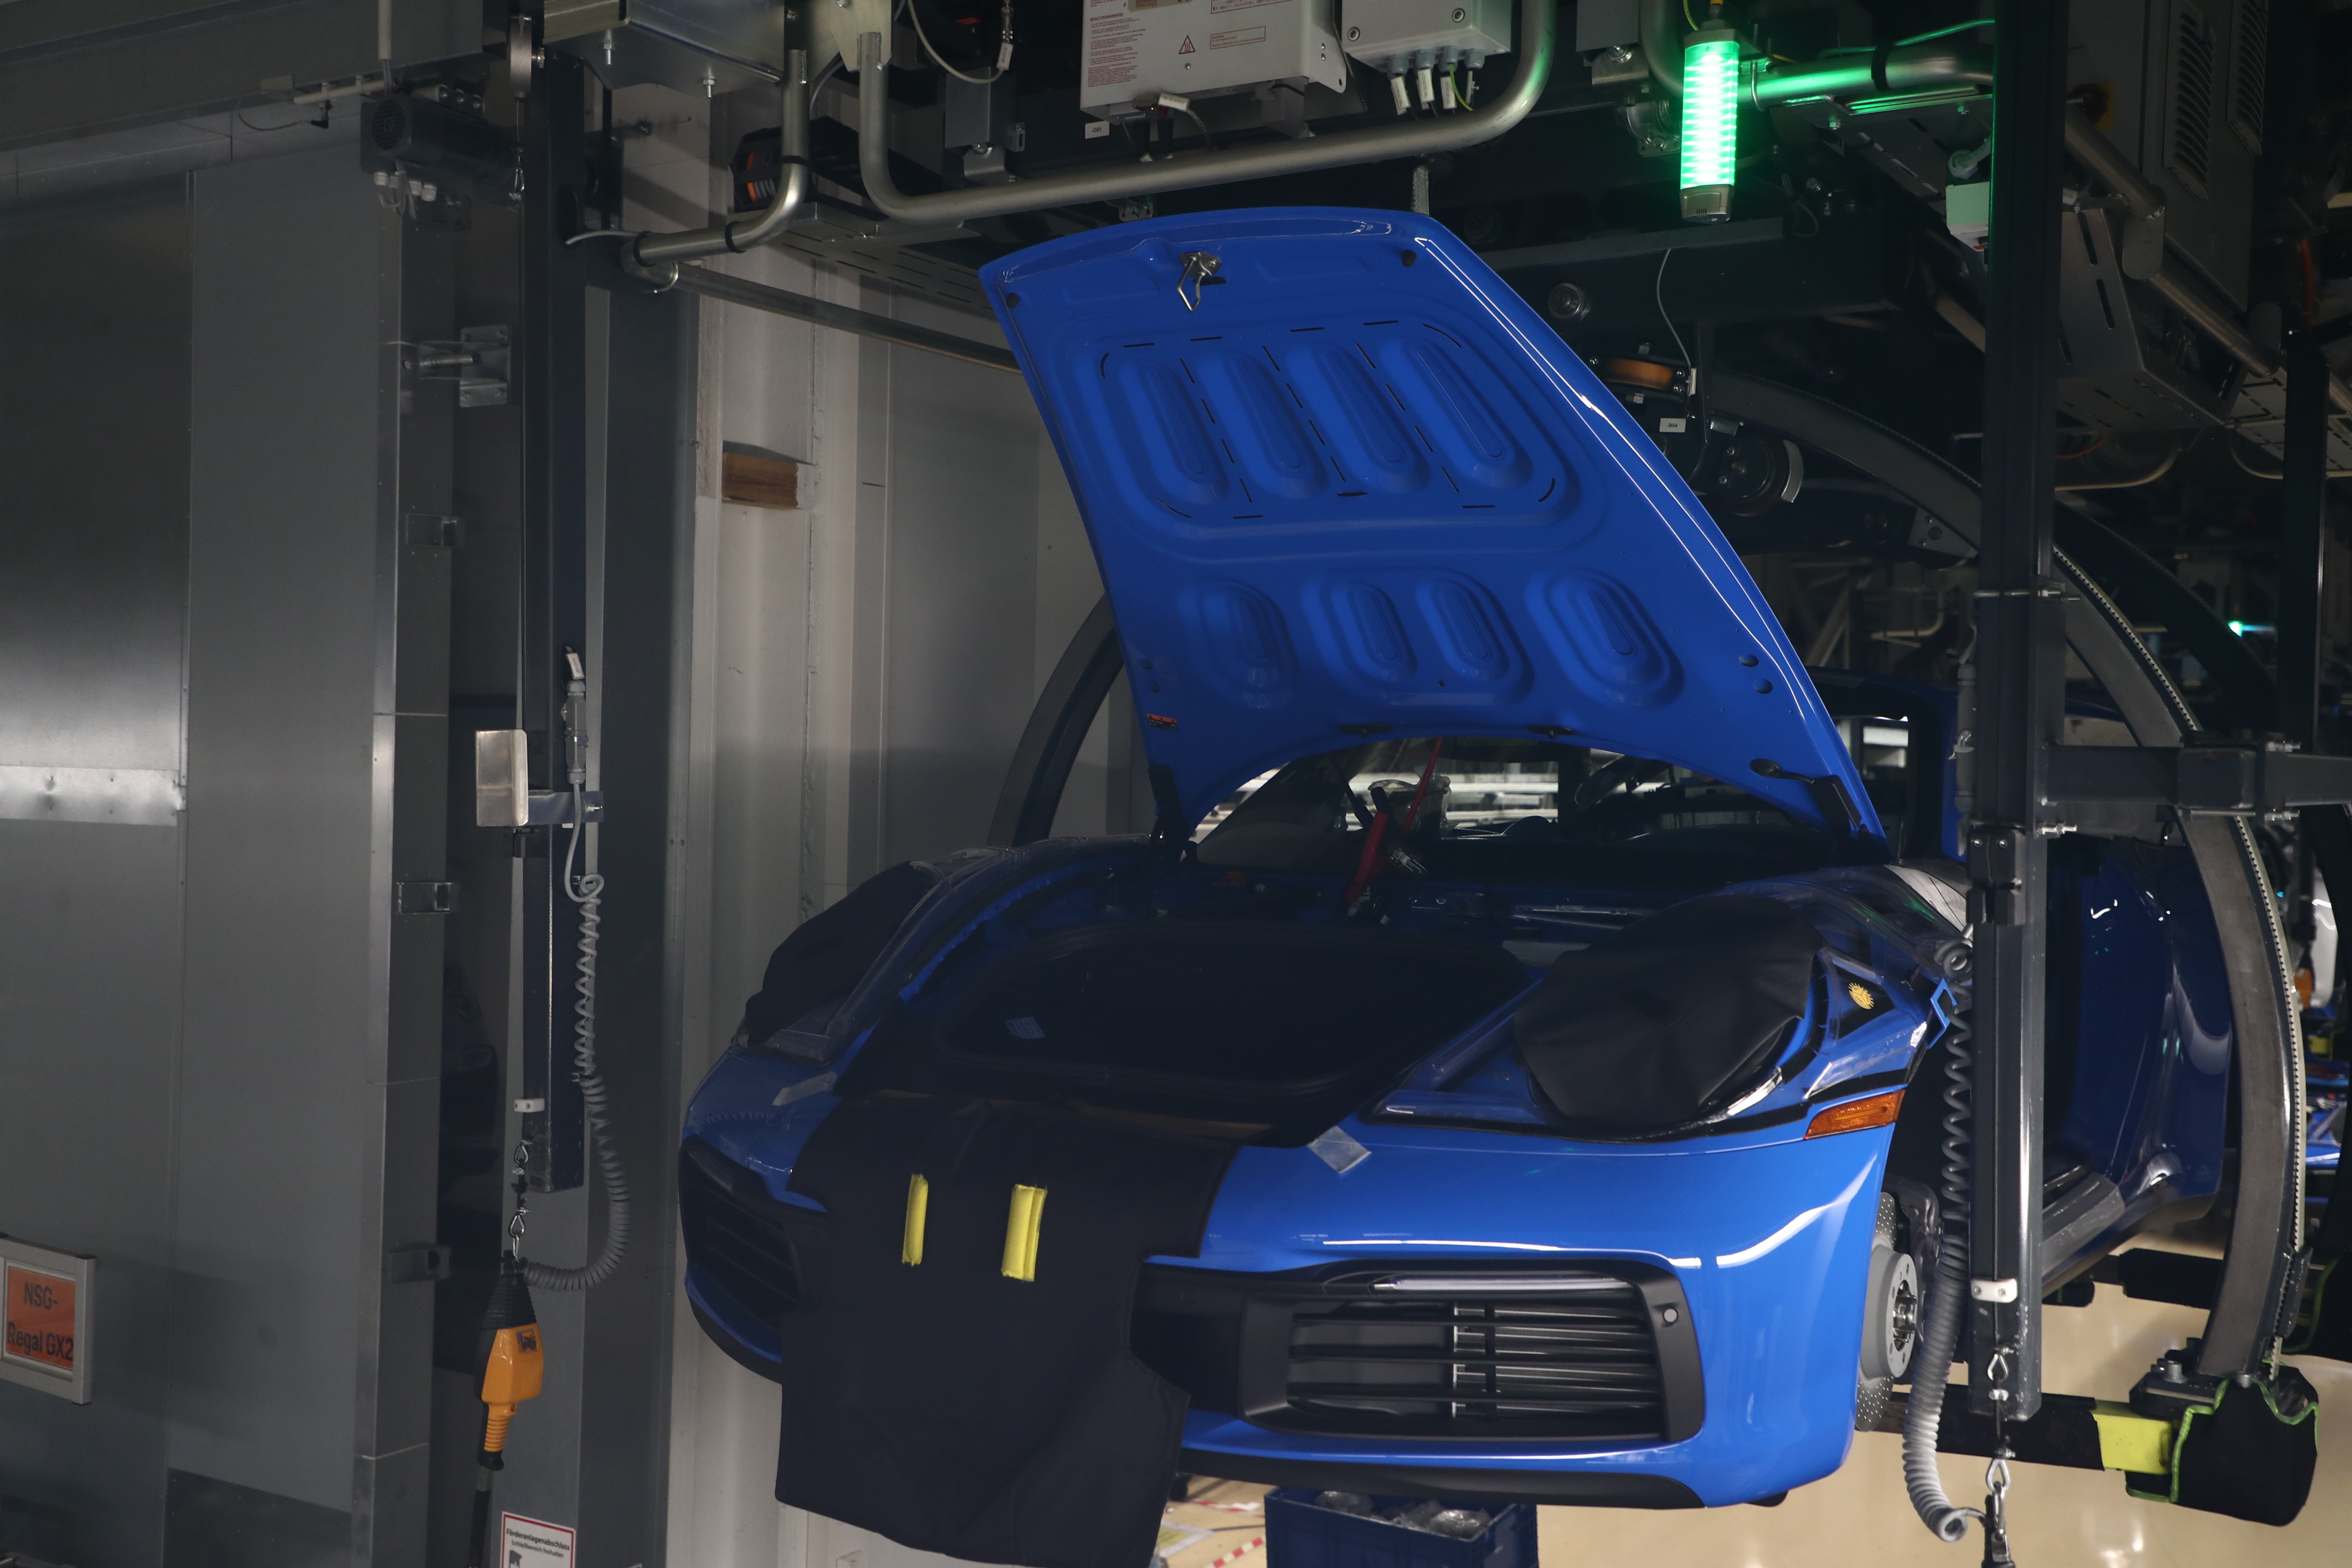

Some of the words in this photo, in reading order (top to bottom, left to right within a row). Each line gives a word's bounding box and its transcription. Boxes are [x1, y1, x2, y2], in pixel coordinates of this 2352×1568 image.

[24, 1282, 58, 1310] NSG-
[7, 1322, 43, 1355] Regal
[46, 1332, 74, 1361] GX2
